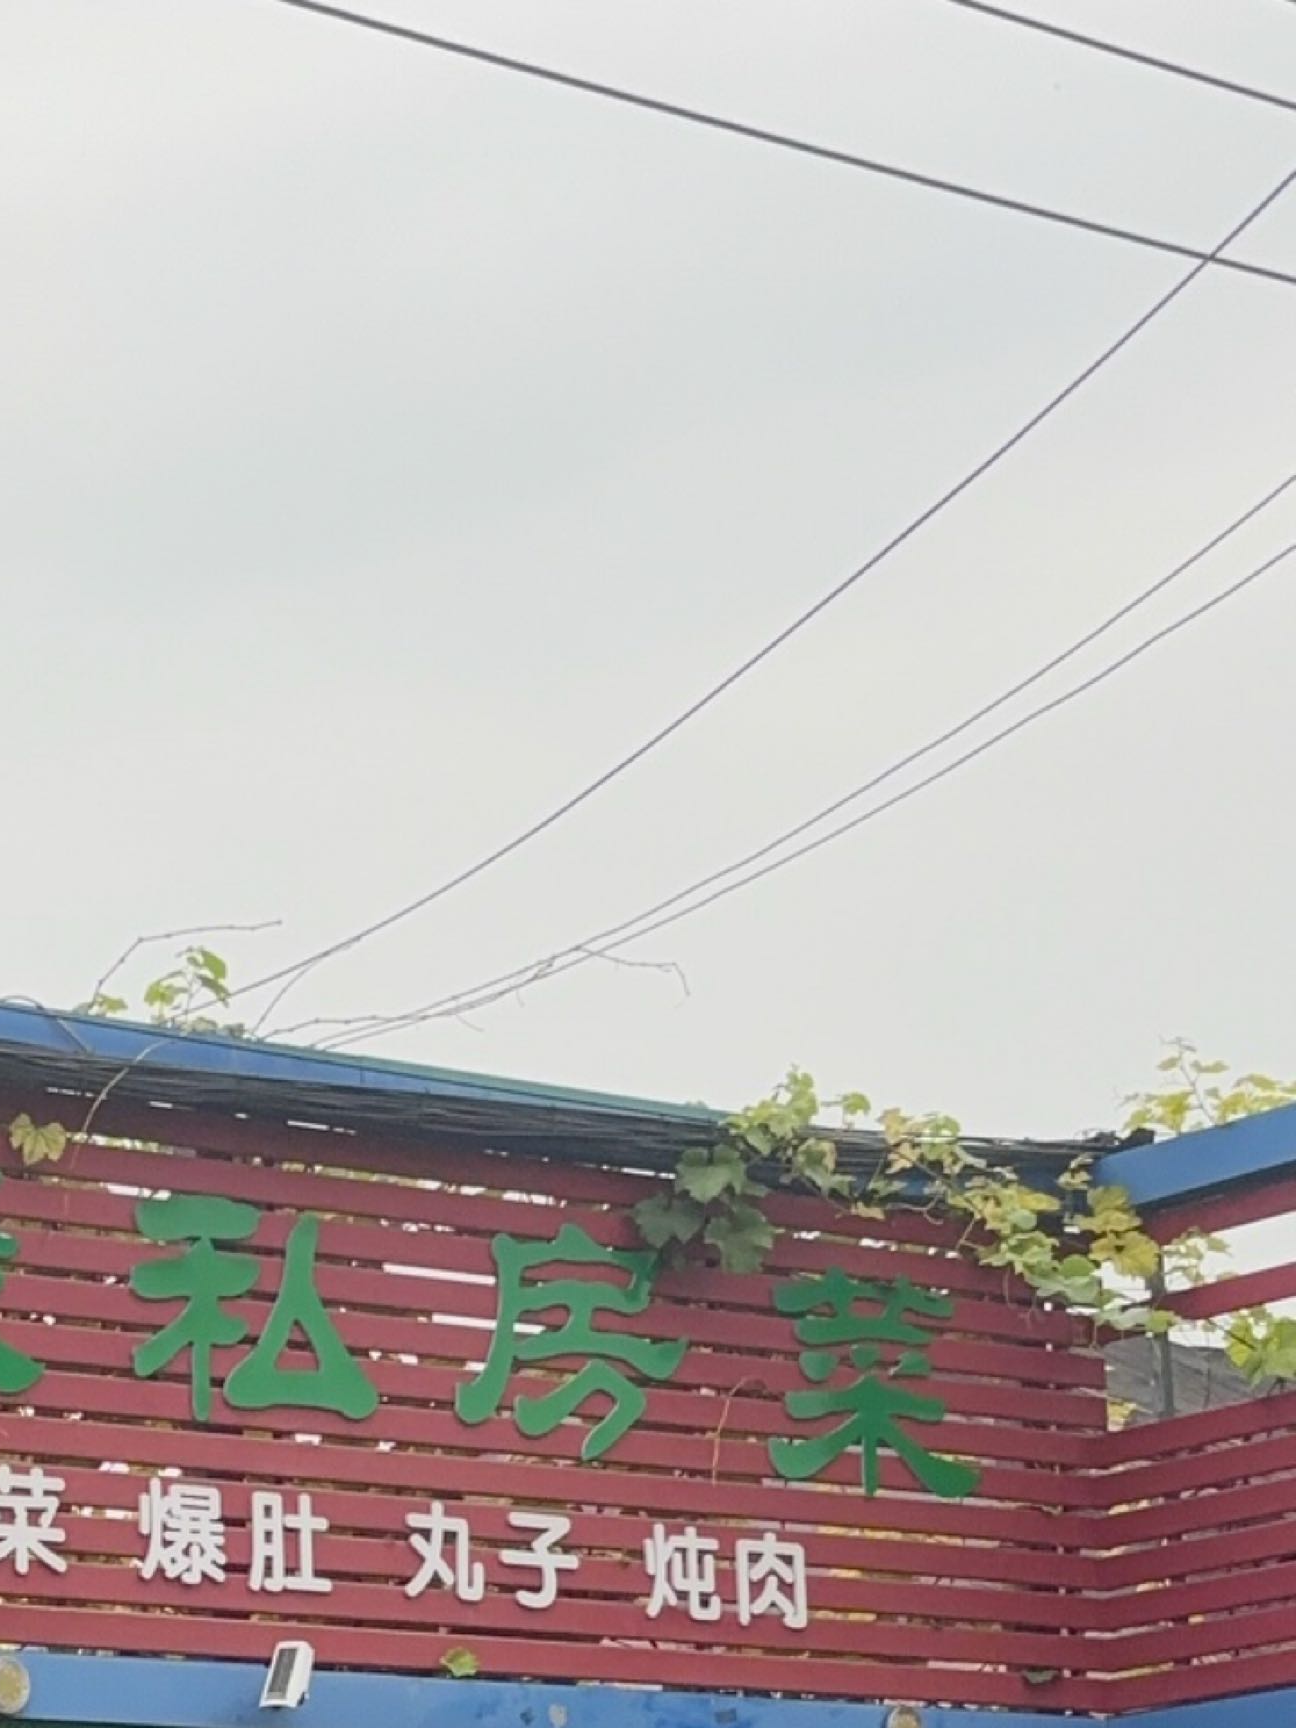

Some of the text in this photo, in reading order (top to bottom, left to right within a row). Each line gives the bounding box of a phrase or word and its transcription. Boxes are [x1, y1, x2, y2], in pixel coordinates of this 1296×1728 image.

[137, 1475, 333, 1595] 爆肚
[404, 1500, 579, 1610] 丸子
[643, 1523, 810, 1631] 炖肉
